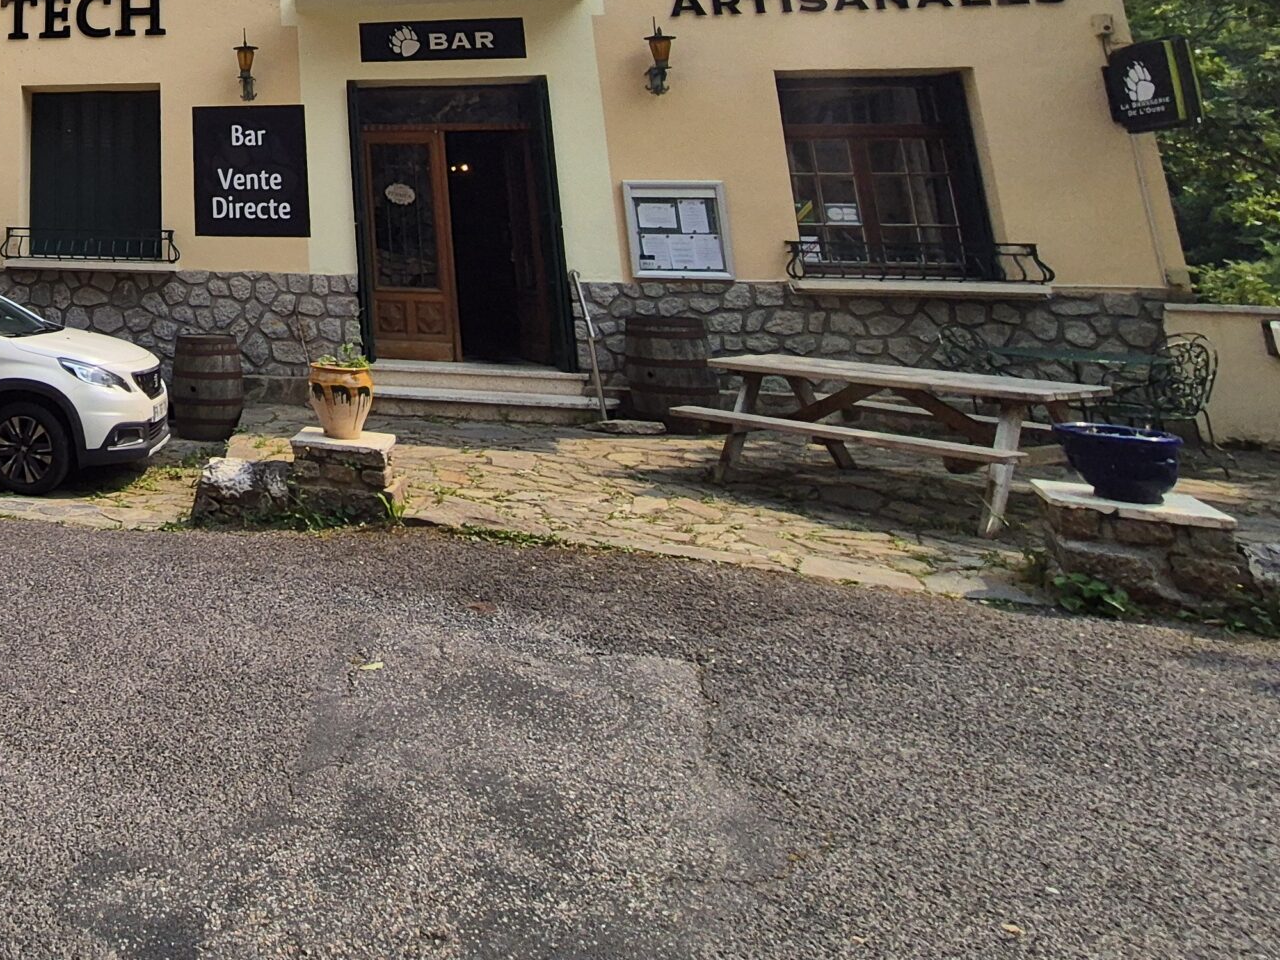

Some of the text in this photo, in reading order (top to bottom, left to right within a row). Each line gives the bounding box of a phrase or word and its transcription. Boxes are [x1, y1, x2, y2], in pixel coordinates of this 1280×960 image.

[428, 31, 495, 50] BAR
[231, 124, 266, 146] Bar
[217, 168, 282, 190] Vente
[211, 195, 291, 219] Directe
